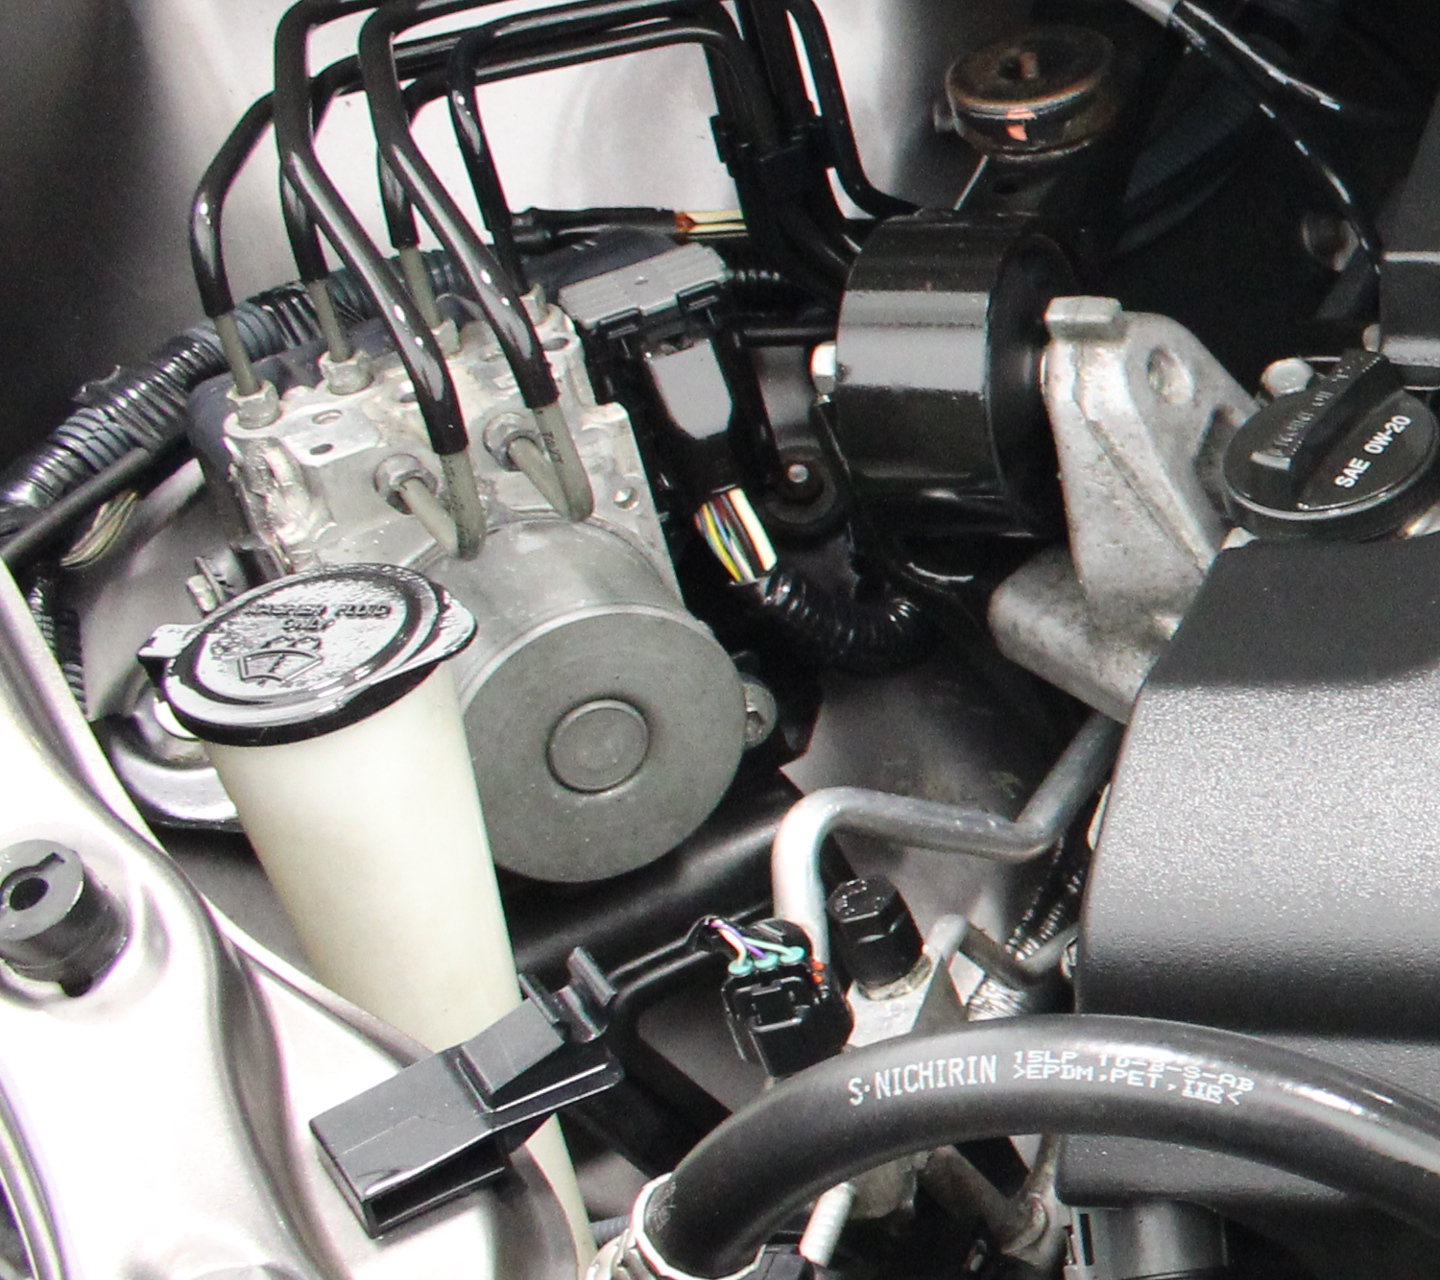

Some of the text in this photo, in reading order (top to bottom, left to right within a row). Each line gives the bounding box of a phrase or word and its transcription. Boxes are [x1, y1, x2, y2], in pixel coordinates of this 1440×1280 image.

[1333, 457, 1371, 489] SAE
[334, 604, 392, 618] FLUID
[1013, 1049, 1079, 1065] 15LP
